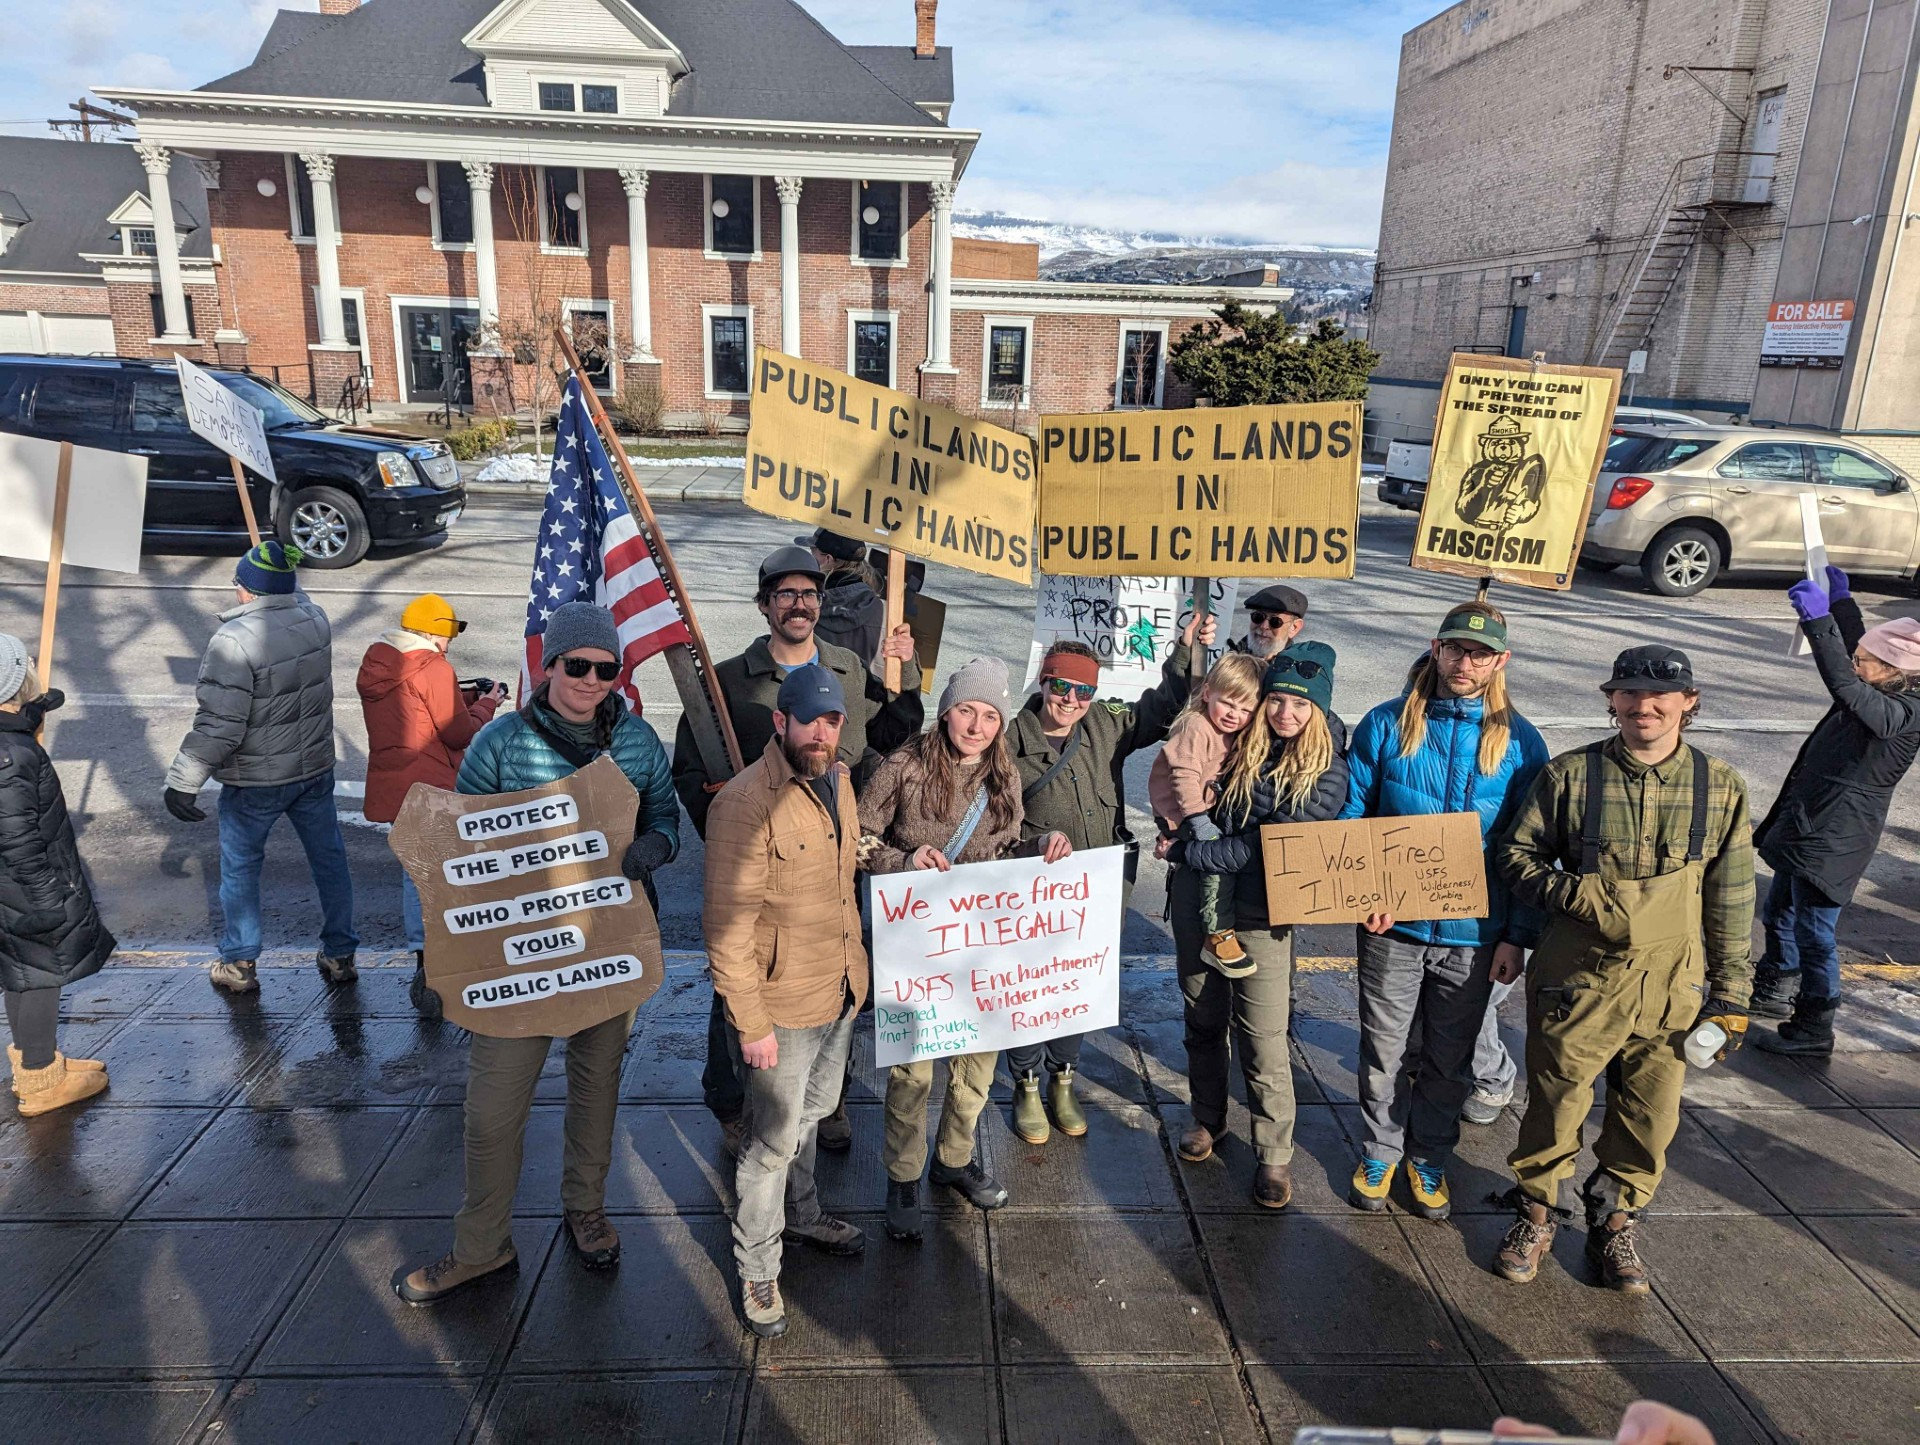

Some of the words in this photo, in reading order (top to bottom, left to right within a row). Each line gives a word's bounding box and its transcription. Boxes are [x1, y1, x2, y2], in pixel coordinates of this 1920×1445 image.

[1776, 304, 1804, 320] FOR
[1806, 302, 1845, 320] SALE
[1793, 322, 1819, 330] Interactive
[1820, 322, 1844, 330] Property
[1458, 374, 1504, 388] ONLY
[1507, 379, 1543, 391] YOU
[1544, 383, 1583, 395] CAN
[1478, 389, 1557, 406] PREVENT
[221, 415, 245, 438] OUR
[760, 358, 909, 439] PUBLIC
[922, 415, 1031, 481] LANDS
[1452, 400, 1487, 412] THE
[1487, 403, 1557, 421] SPREAD
[1559, 410, 1583, 421] OF
[189, 401, 270, 472] DEMOCRACY
[1043, 424, 1195, 463] PUBLIC
[1213, 420, 1352, 460] LANDS
[891, 451, 930, 495] IN
[751, 453, 903, 531] PUBLIC
[916, 505, 1028, 568] HANDS
[1176, 474, 1219, 511] IN
[1043, 525, 1192, 561] PUBLIC
[1210, 525, 1348, 564] HANDS
[1426, 526, 1546, 565] FASCISM
[1084, 630, 1144, 671] YOUR
[1289, 684, 1308, 693] SERVICE
[464, 801, 571, 836] PROTECT
[451, 858, 500, 879] THE
[511, 838, 600, 868] PEOPLE
[1267, 835, 1304, 877] I
[1317, 832, 1366, 873] Was
[1381, 826, 1446, 866] Fired
[1415, 867, 1448, 880] USFS
[454, 906, 510, 928] WHO
[521, 882, 625, 916] PROTECT
[878, 886, 932, 923] We
[949, 891, 1025, 913] were
[1029, 872, 1090, 904] fired
[1299, 870, 1407, 915] Illegally
[1429, 891, 1463, 902] Climbing
[1442, 903, 1478, 914] Ranger
[511, 931, 577, 957] YOUR
[924, 906, 1086, 958] ILLEGALLY
[467, 977, 551, 1005] PUBLIC
[556, 960, 631, 987] LANDS
[976, 979, 1080, 1012] Wilderness
[877, 1005, 937, 1028] Deemed
[916, 1026, 929, 1038] in
[934, 1018, 979, 1040] public
[1011, 1003, 1090, 1032] Rangers
